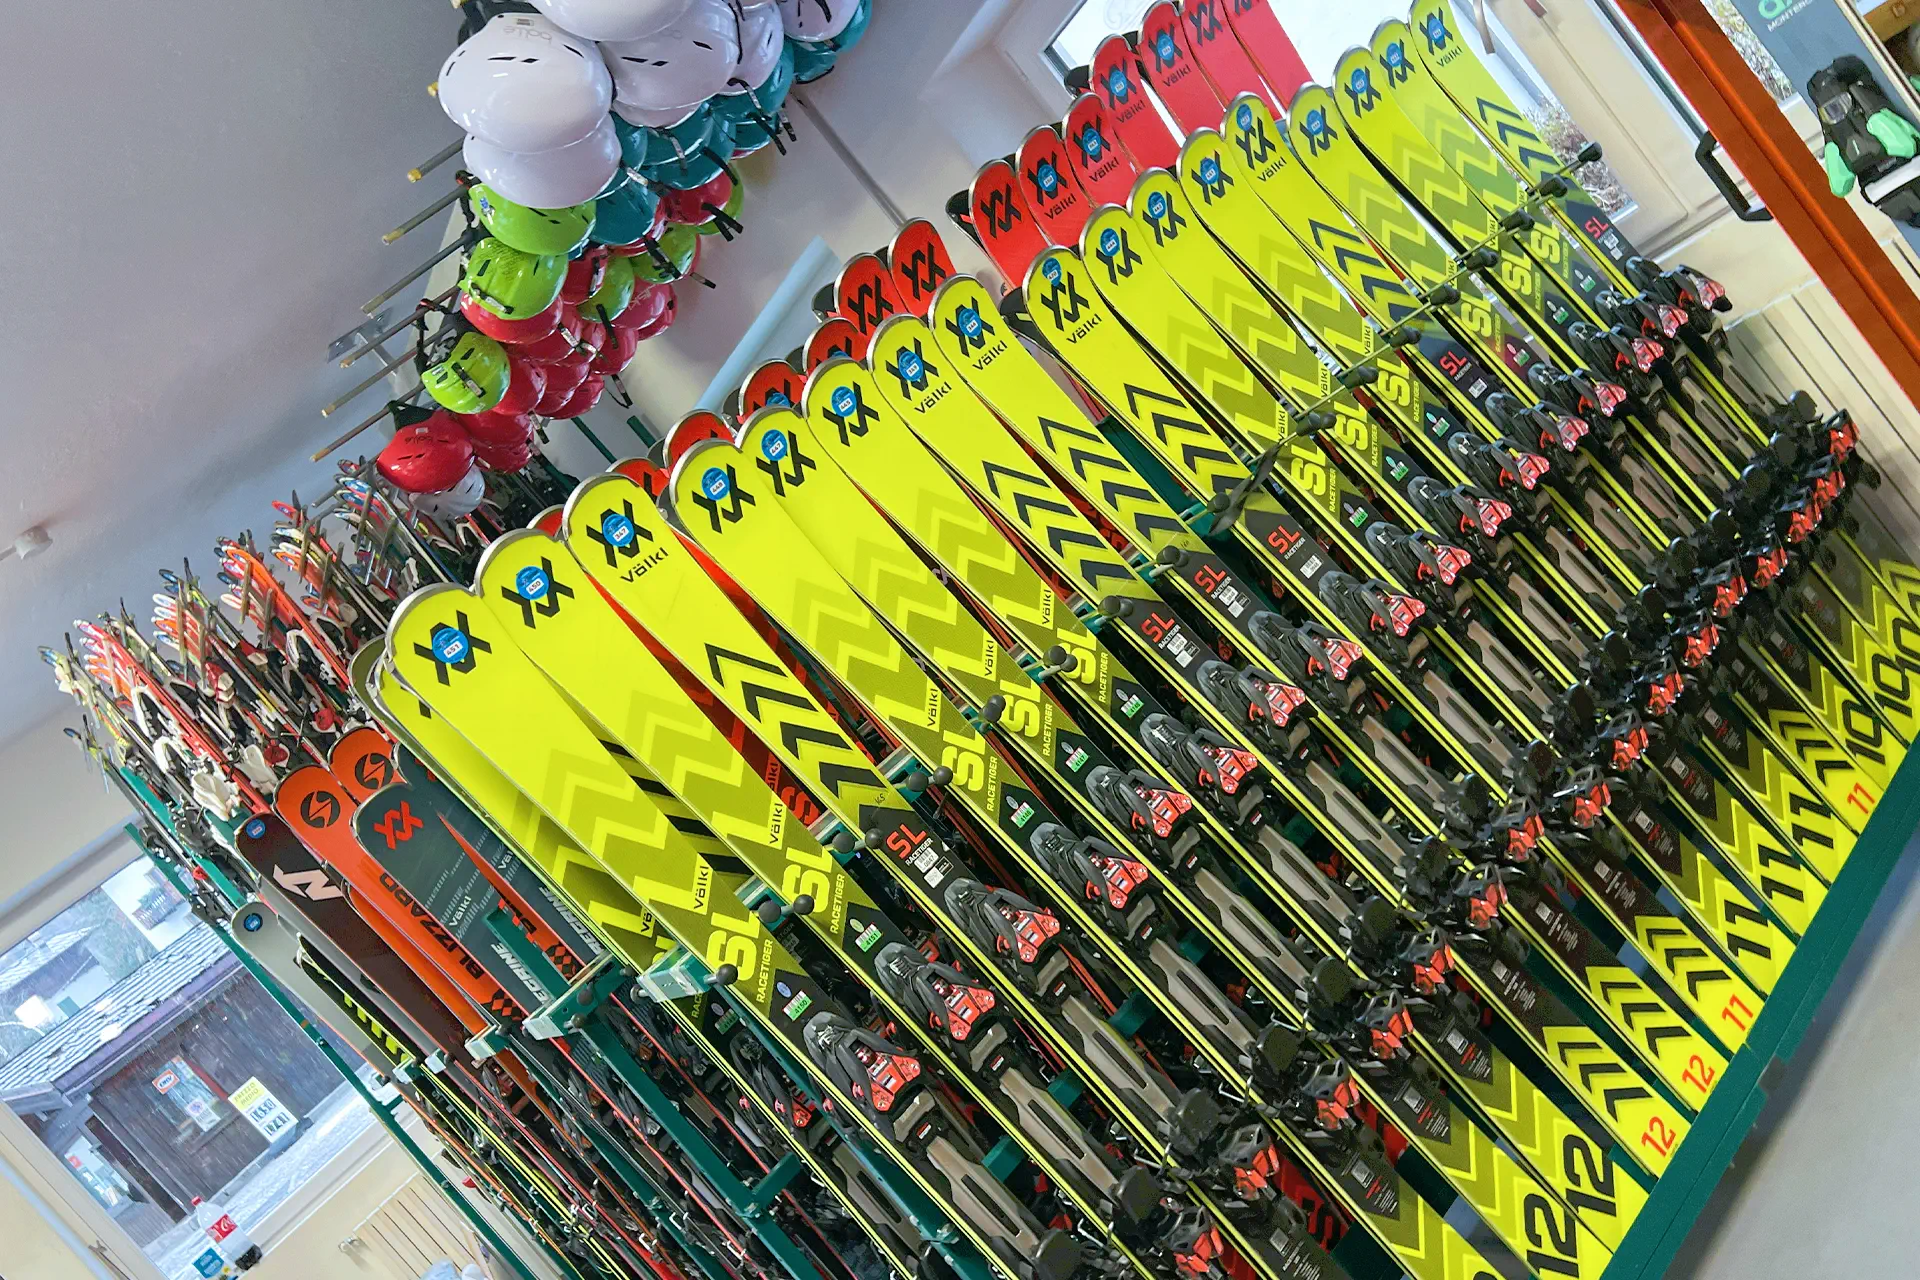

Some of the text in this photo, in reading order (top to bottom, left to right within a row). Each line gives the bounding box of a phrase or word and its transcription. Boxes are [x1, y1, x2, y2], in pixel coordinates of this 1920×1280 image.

[1088, 156, 1120, 183] Völkl
[1257, 156, 1288, 183] Völkl
[1043, 193, 1077, 221] Völkl
[1584, 216, 1609, 239] SL
[1531, 222, 1560, 264] SL
[1501, 250, 1532, 295] SL
[1066, 313, 1103, 344] Völkl
[1461, 292, 1491, 337] SL
[972, 340, 1009, 371] Völkl
[1439, 351, 1467, 376] SL
[914, 381, 953, 414] Völkl
[1377, 357, 1410, 408] SL
[1334, 401, 1368, 451] SL
[1291, 444, 1326, 496] SL
[614, 528, 627, 540] 347
[1267, 525, 1300, 554] SL
[528, 580, 542, 592] 450
[620, 547, 669, 583] Völkl
[1194, 564, 1226, 593] SL
[1042, 589, 1052, 625] Völkl
[1141, 612, 1175, 643] SL
[446, 643, 460, 656] 451
[984, 640, 995, 677] Völkl
[1099, 651, 1109, 703] RACETIGER
[1872, 653, 1913, 718] 10
[927, 688, 940, 727] Völkl
[1000, 679, 1041, 738] SL
[1043, 703, 1053, 757] RACETIGER
[1841, 699, 1886, 766] 10
[942, 730, 986, 792] SL
[986, 755, 998, 812] RACETIGER
[1846, 782, 1875, 815] 11
[769, 802, 783, 845] Völkl
[886, 823, 927, 859] SL
[1788, 792, 1834, 850] 11
[905, 837, 934, 866] RACETIGER
[693, 865, 710, 910] Völkl
[782, 847, 833, 913] SL
[1757, 843, 1805, 903] 11
[830, 873, 845, 935] RACETIGER
[379, 872, 485, 980] BLIZZARD
[707, 912, 761, 981] SL
[865, 932, 878, 946] 4151
[1724, 899, 1771, 960] 11
[755, 939, 773, 1003] RACETIGER
[794, 999, 808, 1014] 4150
[1721, 993, 1754, 1032] 11
[1681, 1054, 1715, 1094] 12
[1641, 1116, 1676, 1158] 12
[1562, 1133, 1617, 1218] 12
[1523, 1193, 1579, 1279] 12
